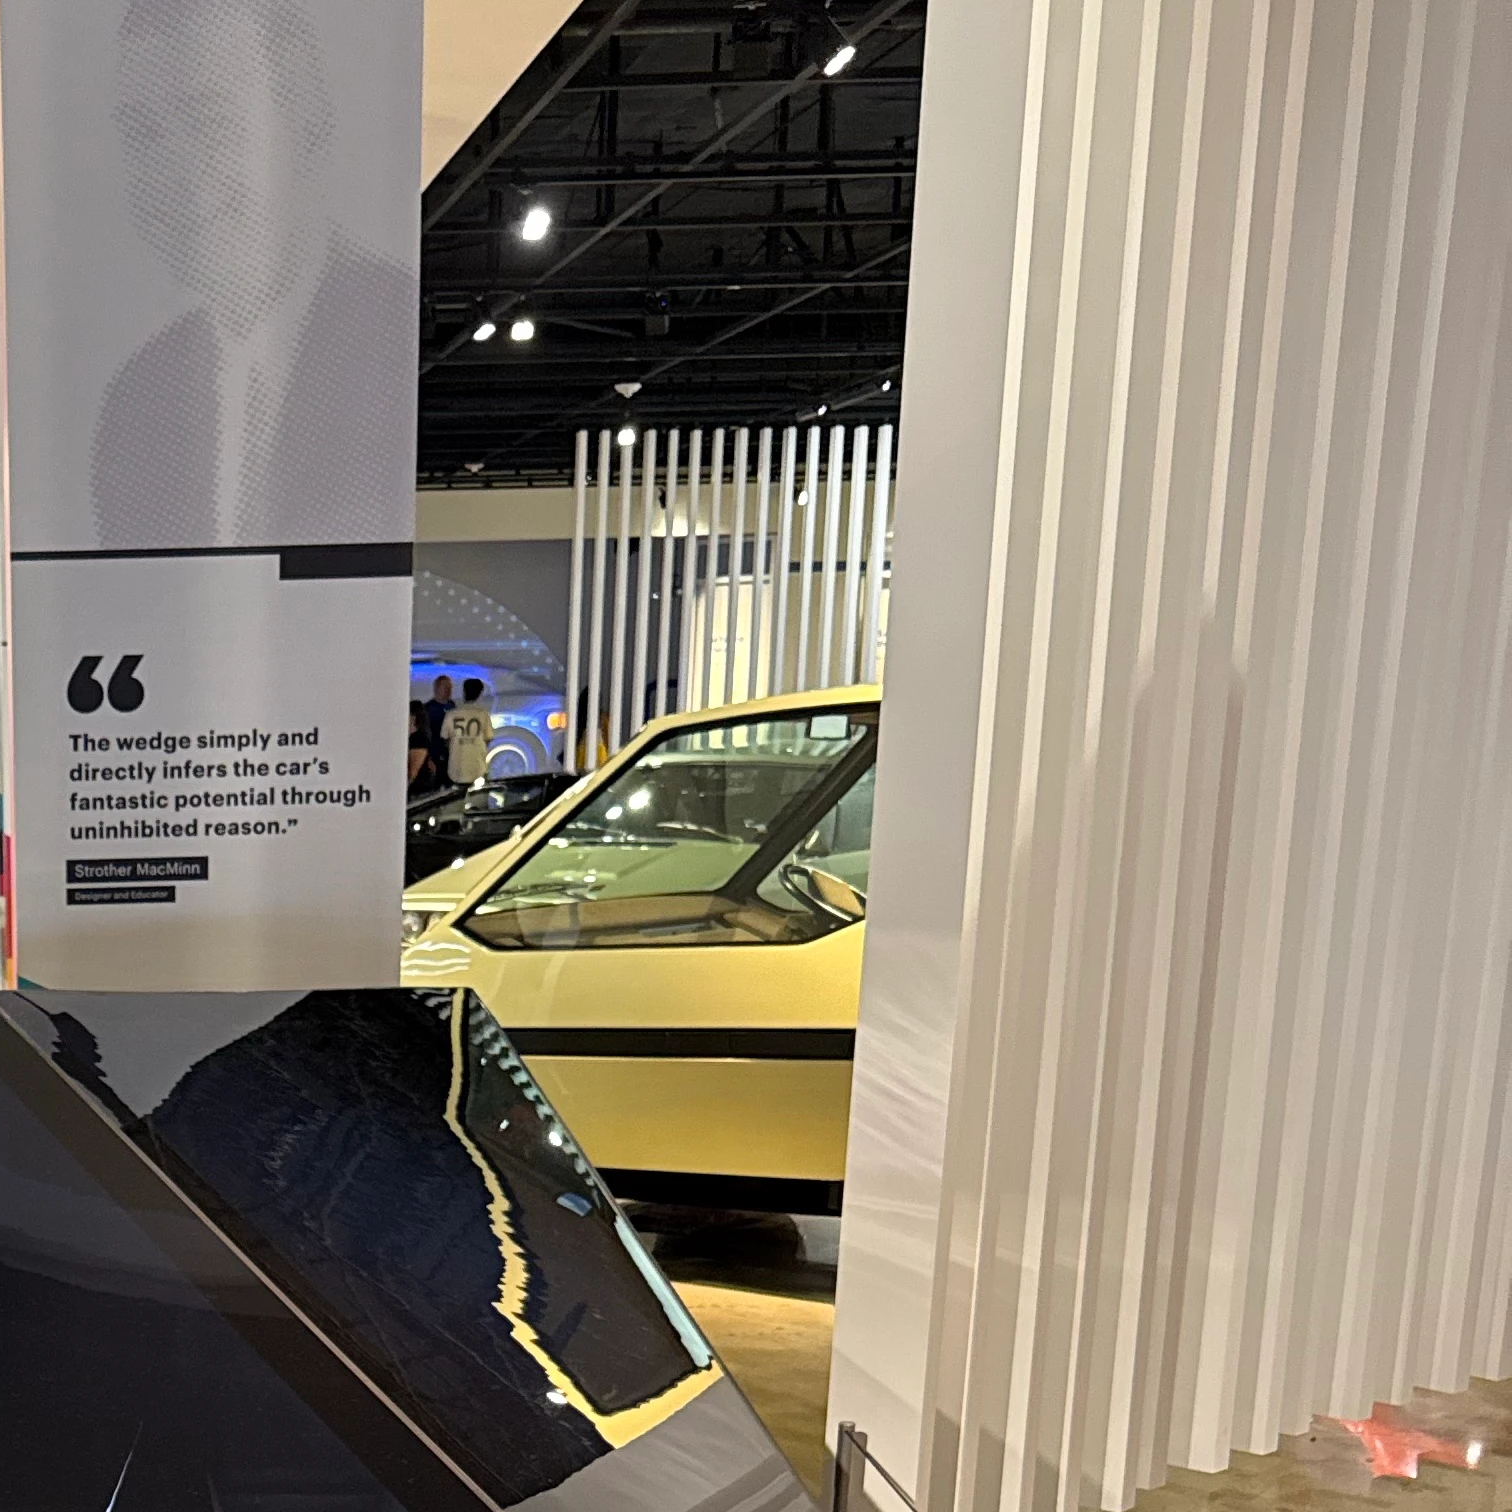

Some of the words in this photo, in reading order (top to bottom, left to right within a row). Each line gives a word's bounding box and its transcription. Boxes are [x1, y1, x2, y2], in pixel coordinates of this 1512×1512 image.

[453, 717, 482, 738] 50
[69, 733, 110, 752] The
[116, 732, 191, 753] wedge
[196, 728, 272, 752] simply
[276, 727, 319, 747] and
[69, 761, 157, 784] directly
[162, 759, 227, 780] infers
[233, 758, 269, 778] the
[275, 756, 330, 777] car’s
[69, 790, 169, 812] fantastic
[174, 787, 276, 813] potential
[281, 784, 372, 808] through
[70, 818, 198, 841] uninhibited
[74, 862, 132, 879] Strother
[136, 861, 201, 877] MacMinn
